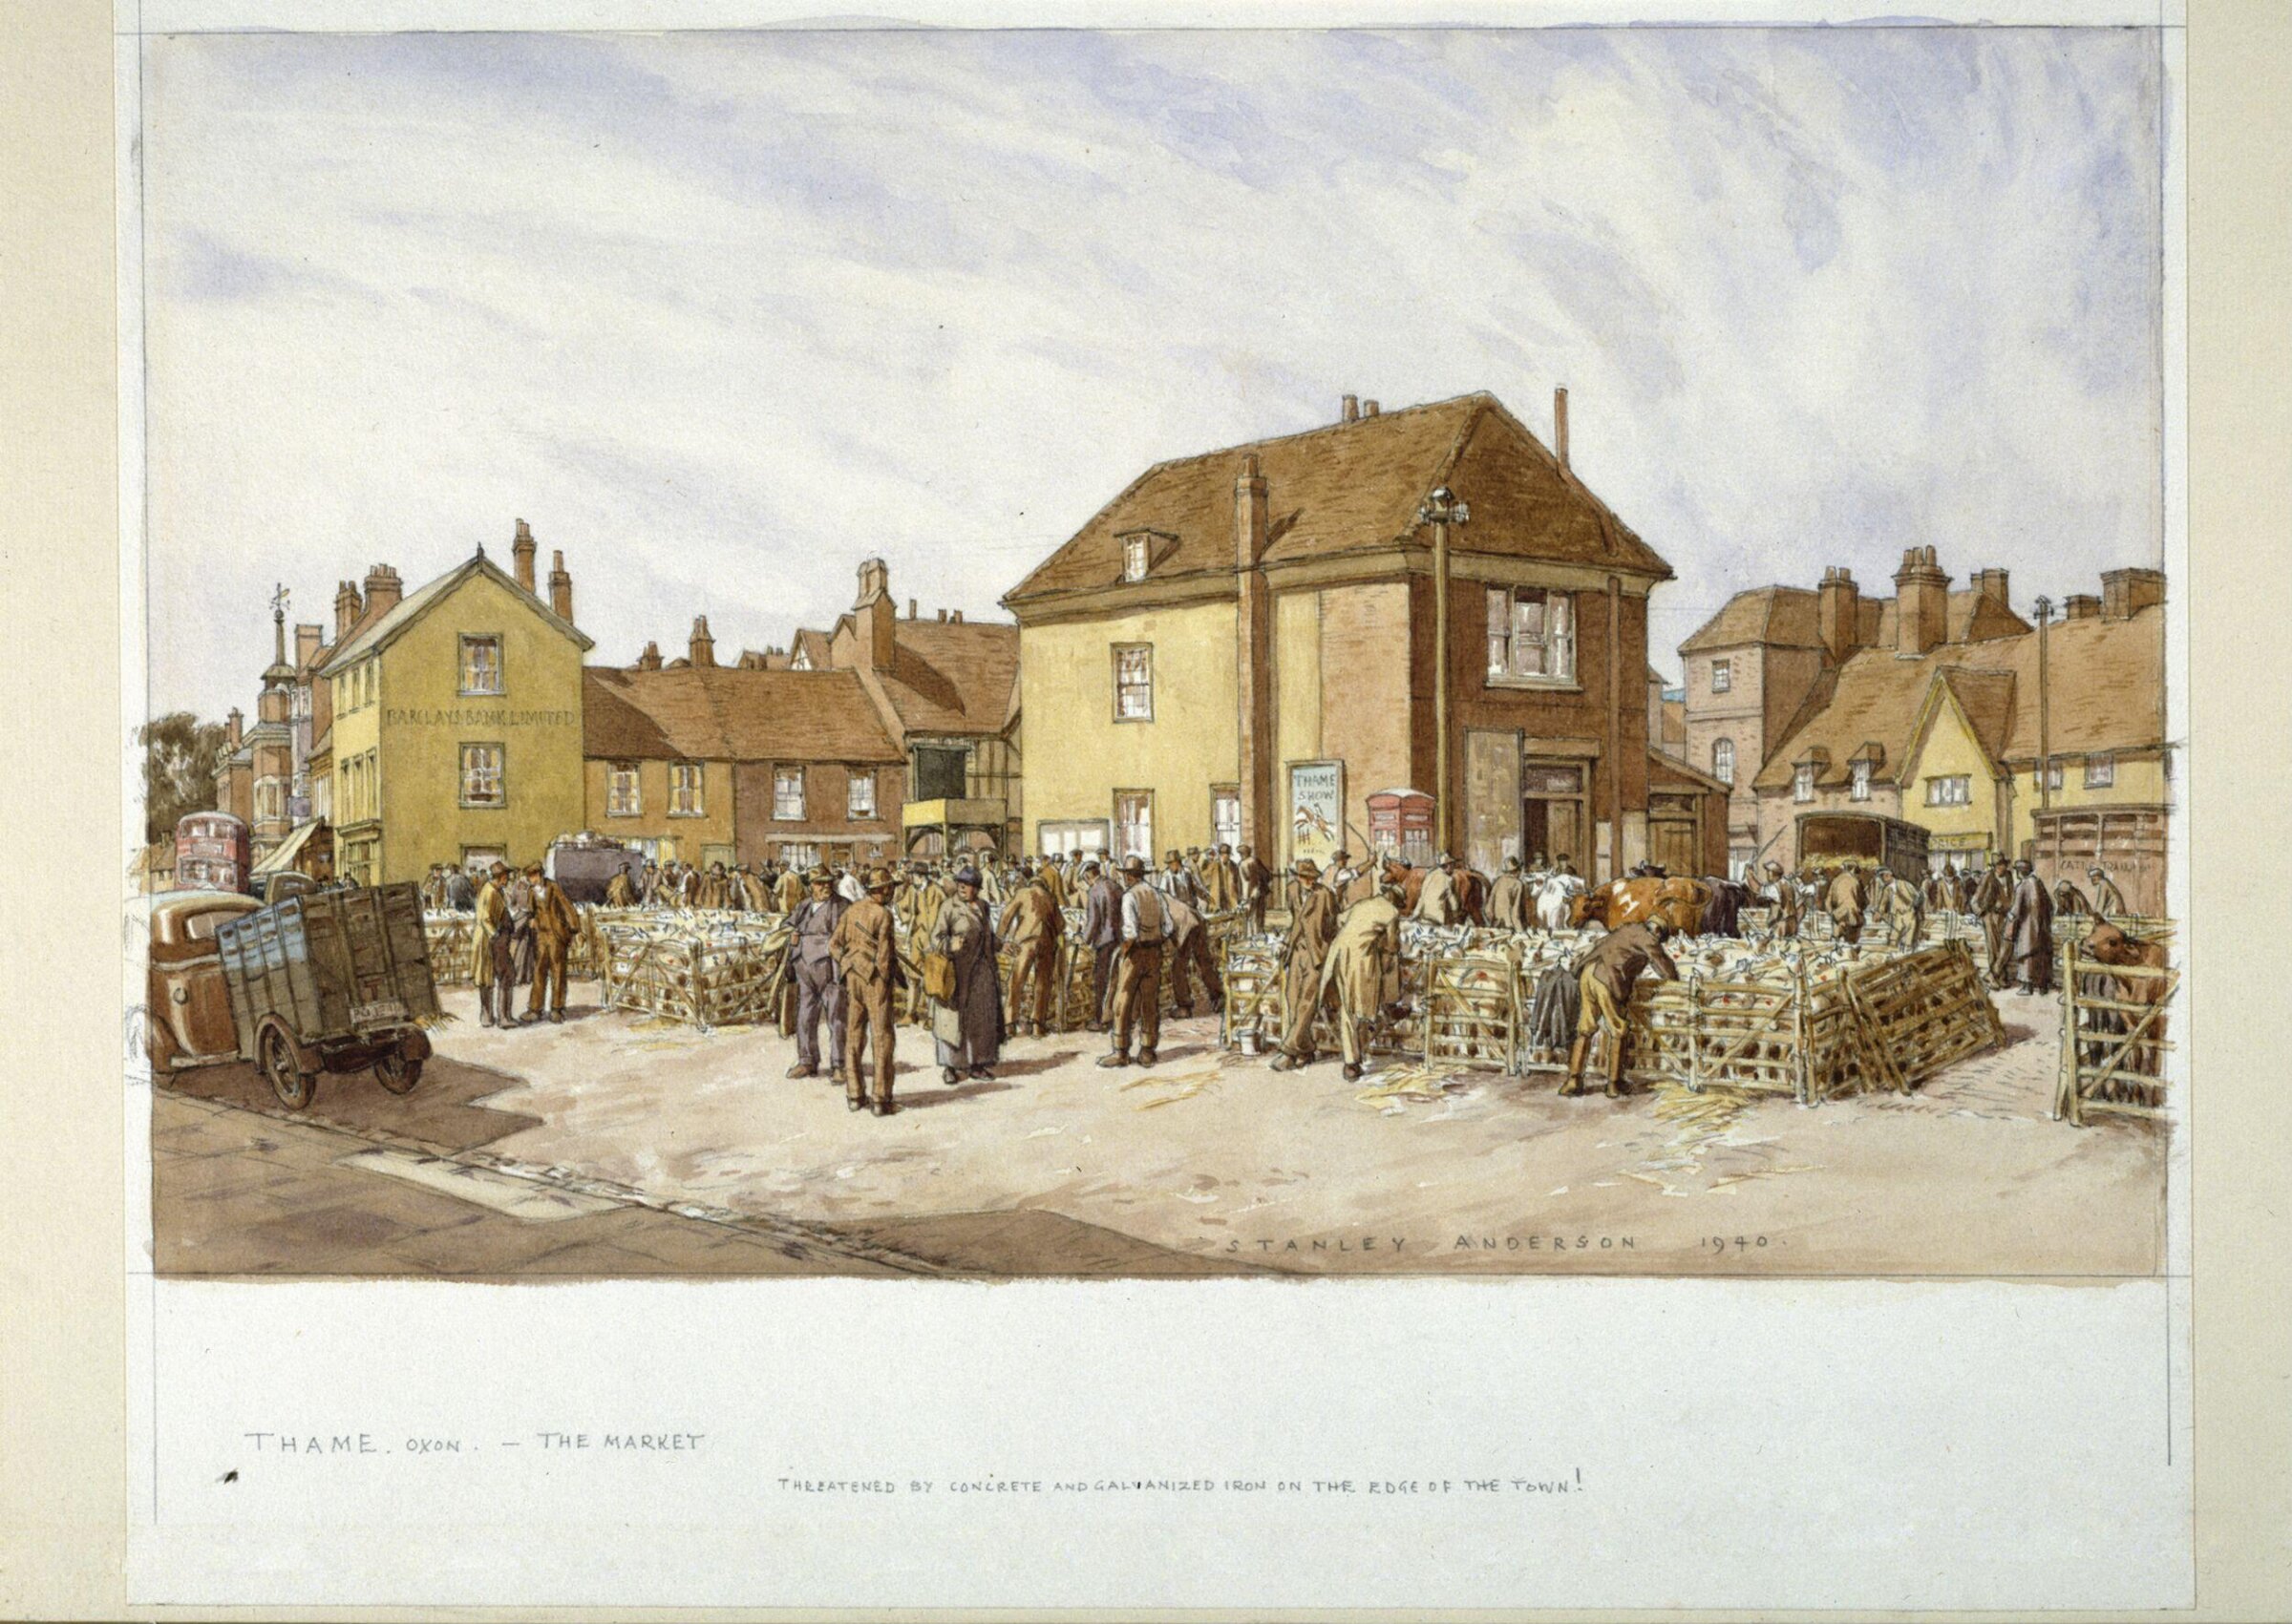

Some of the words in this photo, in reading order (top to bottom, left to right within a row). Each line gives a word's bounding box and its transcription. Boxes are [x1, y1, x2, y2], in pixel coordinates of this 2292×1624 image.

[386, 709, 461, 727] BARCLAYS
[465, 709, 506, 727] BANK
[509, 709, 576, 727] LIMITED
[1294, 773, 1336, 788] THAME
[1297, 790, 1335, 801] SHOW
[1226, 1236, 1406, 1255] STANLEY
[1454, 1234, 1635, 1251] ANDERSON
[537, 1432, 590, 1450] THE
[604, 1433, 707, 1451] MARKET
[777, 1478, 896, 1495] THREATENED
[910, 1480, 934, 1494] BY
[950, 1480, 1043, 1494] CONCRETE
[1053, 1481, 1089, 1493] AND
[1093, 1479, 1216, 1492] GALVANIZED
[1224, 1480, 1267, 1492] IRON
[1277, 1480, 1302, 1493] ON
[1312, 1480, 1357, 1494] THE
[1369, 1480, 1419, 1495] EDGE
[1429, 1480, 1453, 1494] OF
[1463, 1479, 1501, 1493] THE
